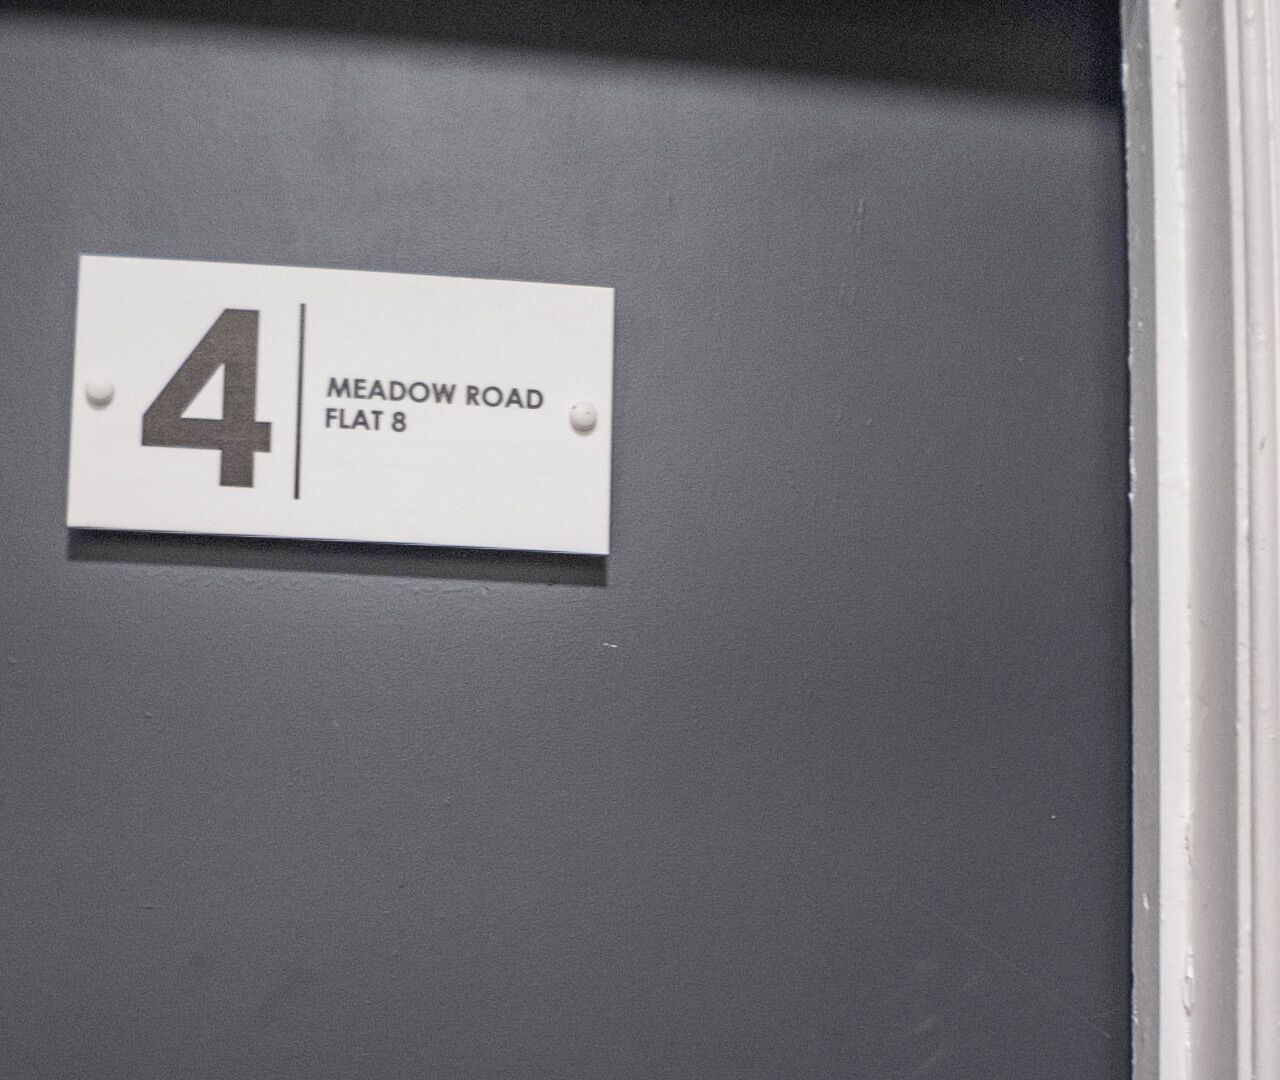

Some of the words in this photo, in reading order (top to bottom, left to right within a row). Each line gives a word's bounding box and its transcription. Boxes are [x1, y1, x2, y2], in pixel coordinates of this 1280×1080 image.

[141, 308, 272, 488] 4
[326, 377, 456, 404] MEADOW
[466, 385, 544, 409] ROAD
[325, 408, 384, 431] FLAT
[391, 412, 407, 432] 8
